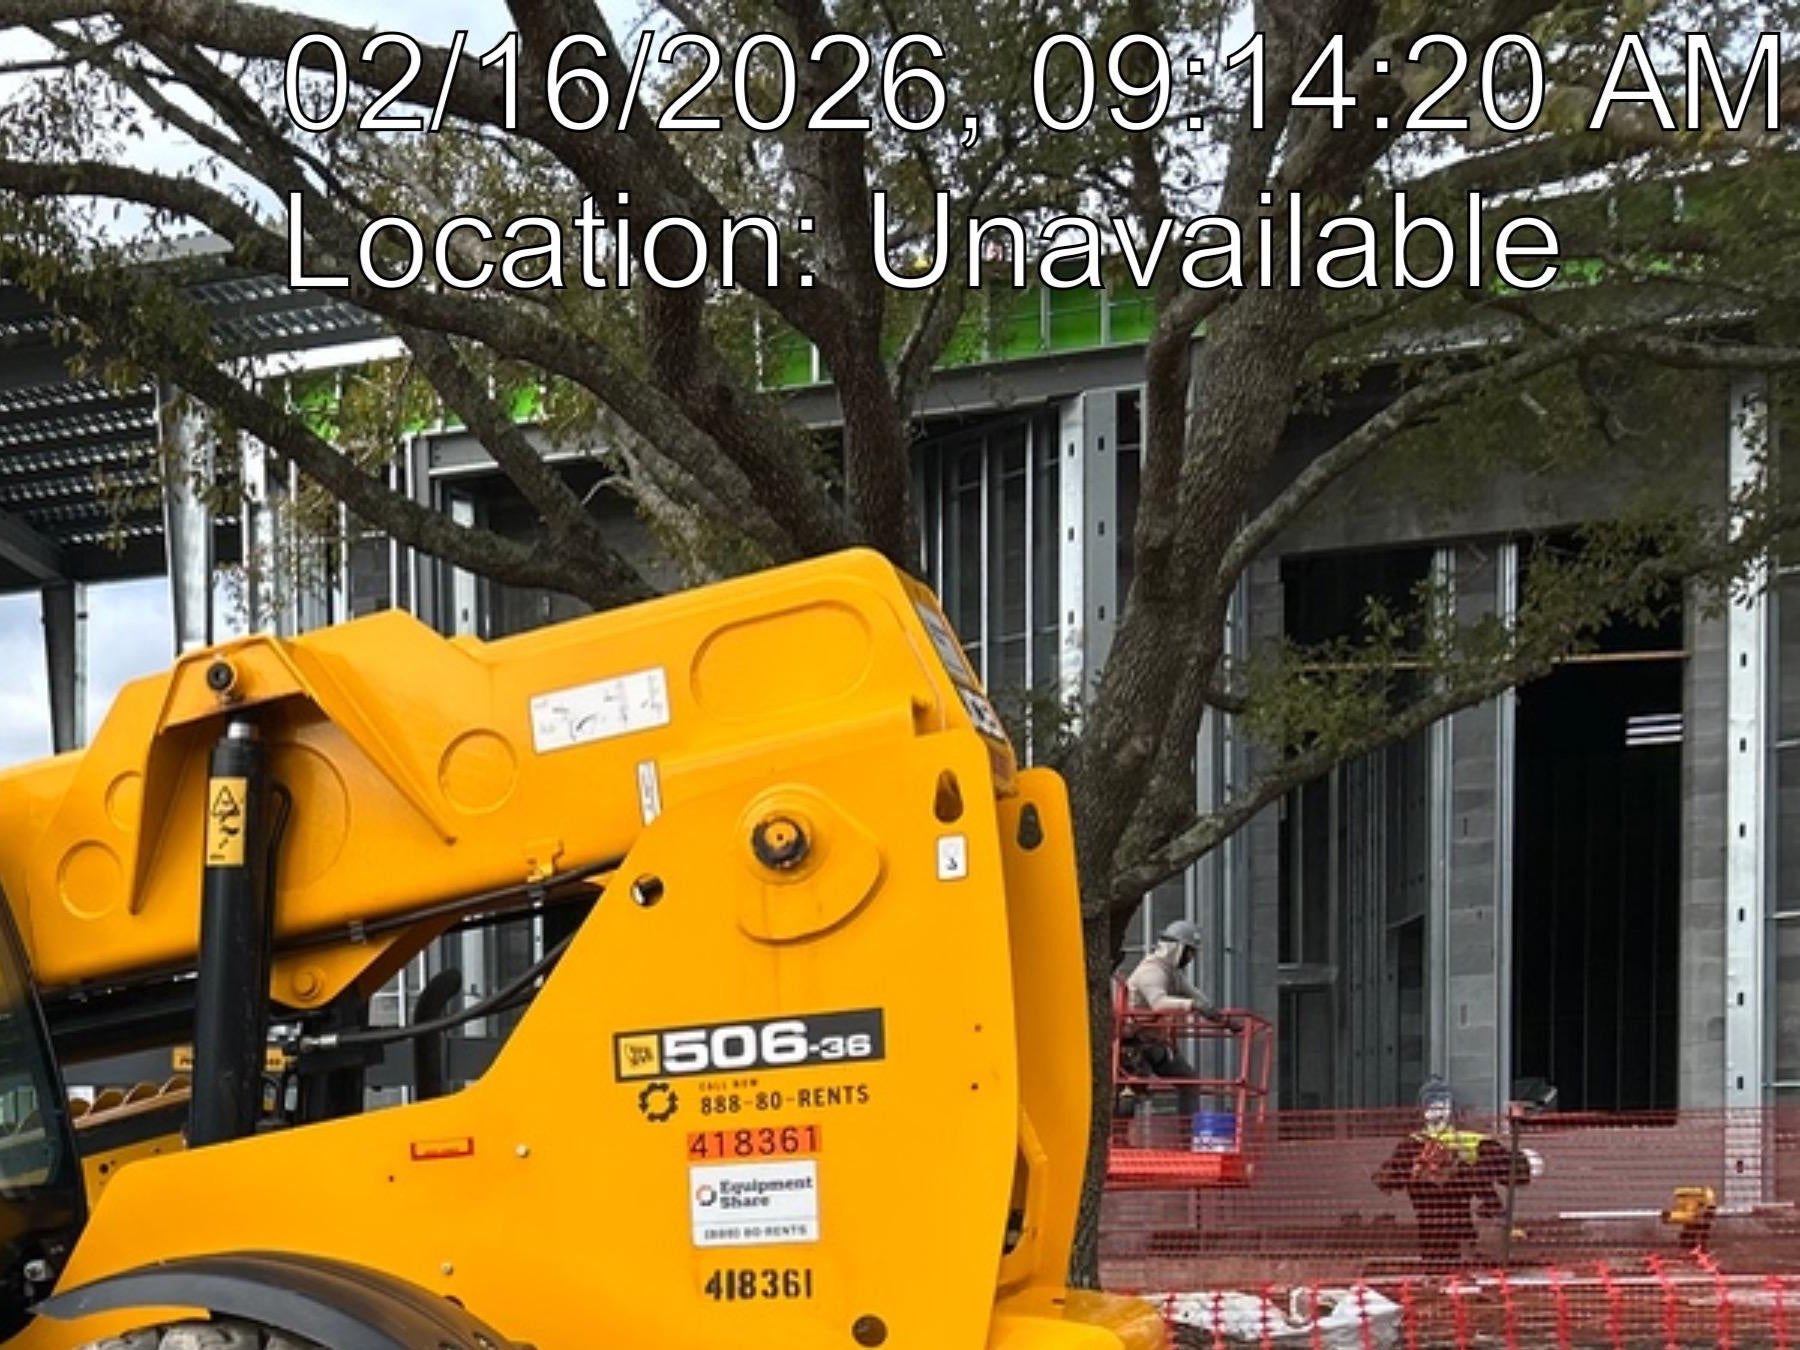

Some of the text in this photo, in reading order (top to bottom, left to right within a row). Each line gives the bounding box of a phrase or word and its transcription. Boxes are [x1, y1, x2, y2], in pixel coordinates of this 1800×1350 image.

[662, 1020, 872, 1073] 506-36
[701, 1085, 870, 1115] 888-80-RENTS
[690, 1125, 817, 1158] 418361
[719, 1176, 814, 1196] Equipment
[719, 1195, 770, 1210] Share
[704, 1268, 813, 1301] 418361
